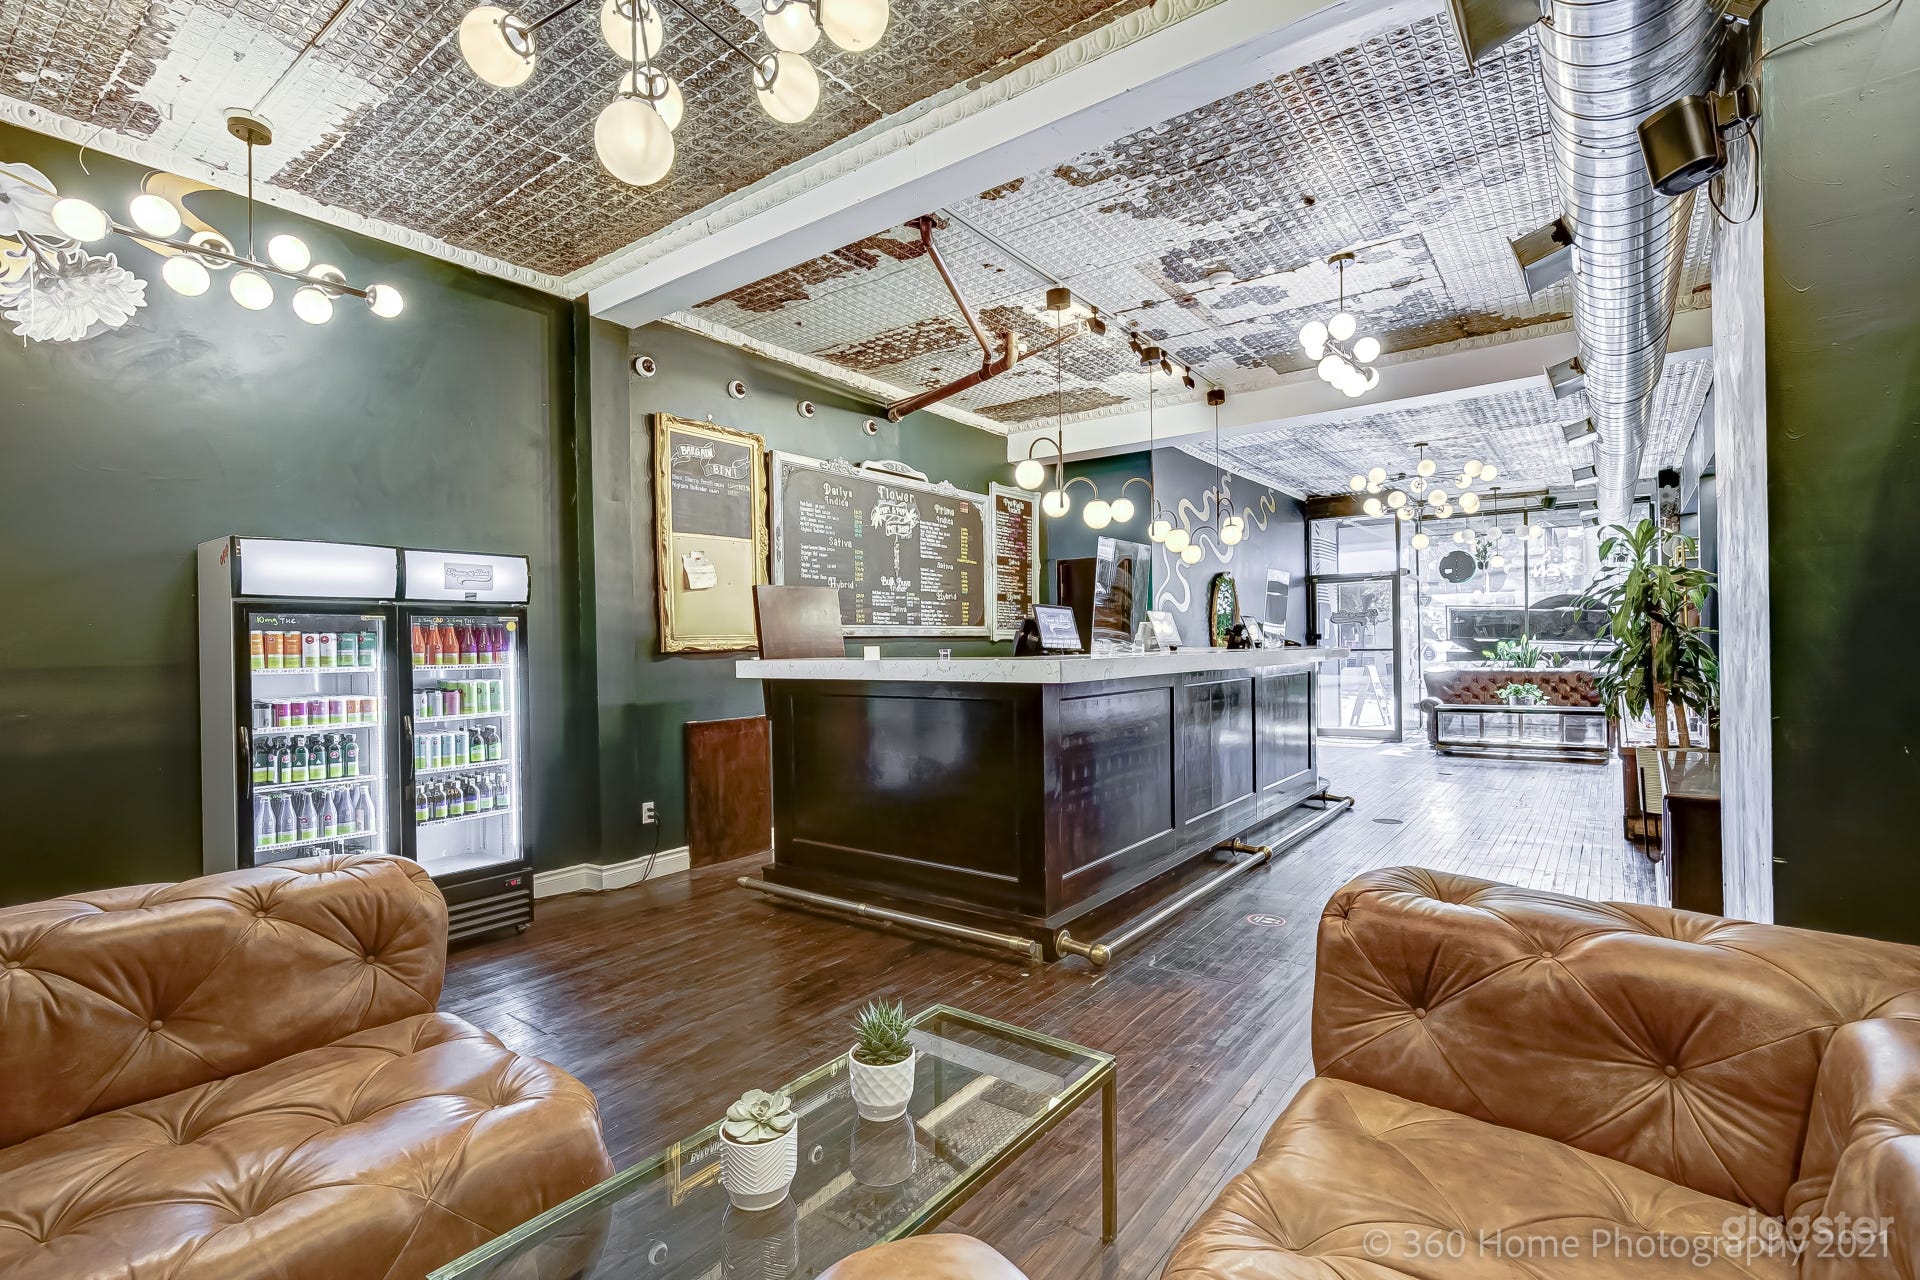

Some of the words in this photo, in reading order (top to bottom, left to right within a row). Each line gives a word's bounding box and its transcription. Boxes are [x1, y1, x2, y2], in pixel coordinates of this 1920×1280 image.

[680, 446, 714, 459] BARGAIN
[713, 465, 737, 478] BIN!
[877, 486, 915, 503] Flower
[825, 496, 849, 507] Indica
[936, 516, 954, 526] Indica
[829, 537, 852, 548] Sativa
[937, 561, 954, 570] Sativa
[828, 579, 854, 591] Hybrid
[936, 592, 957, 602] Hybrid
[256, 617, 278, 625] 10mg
